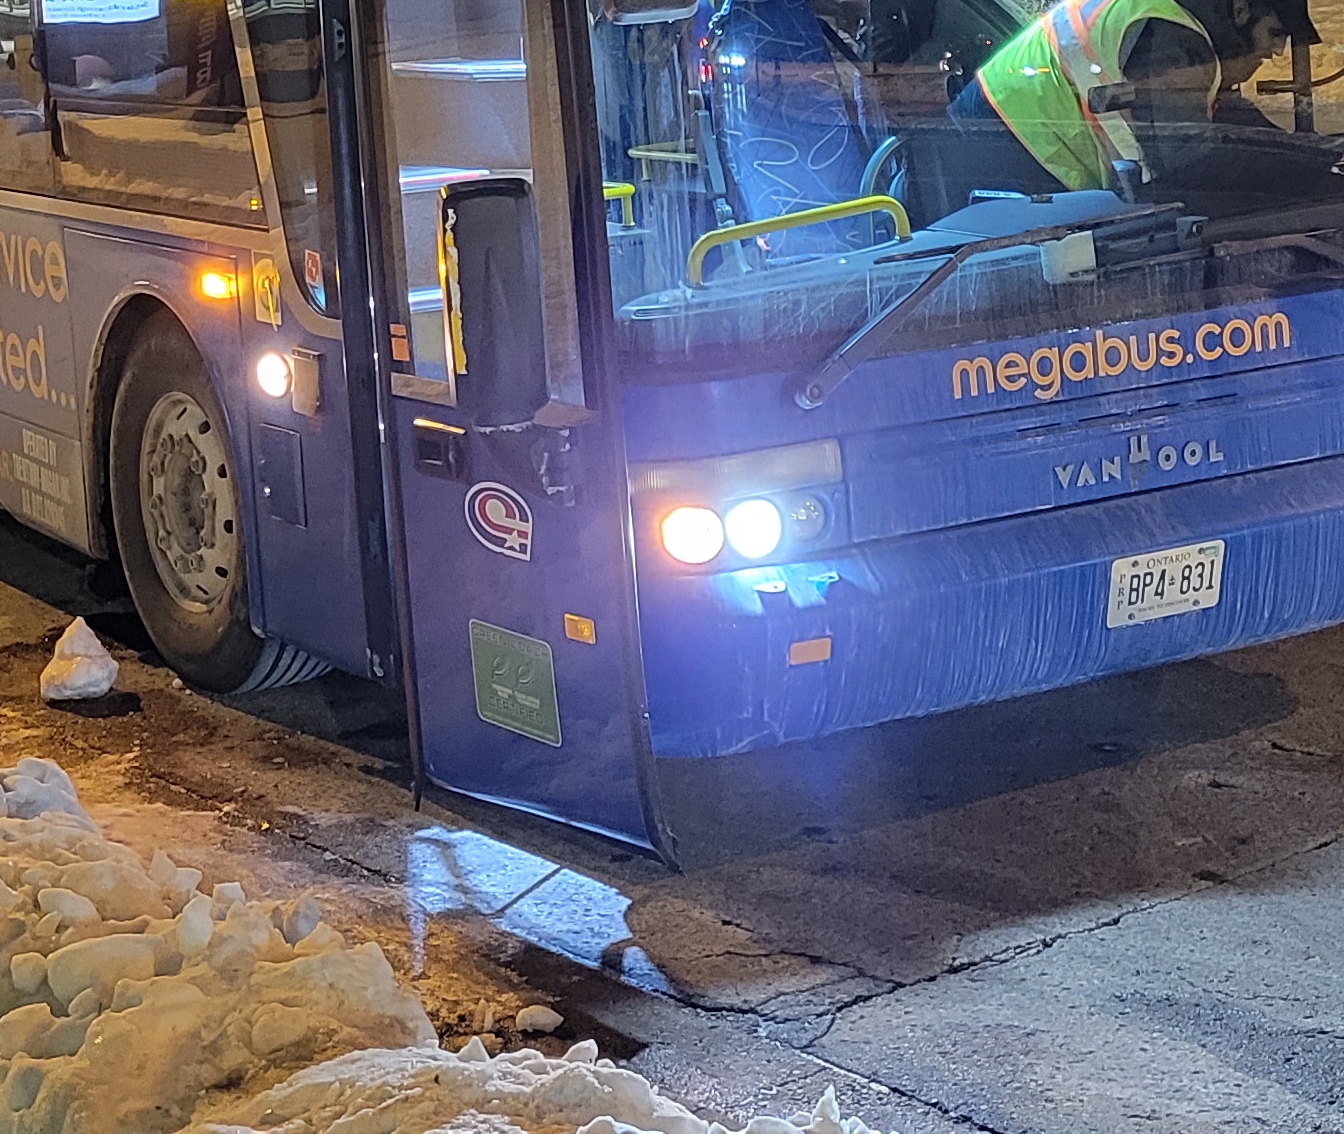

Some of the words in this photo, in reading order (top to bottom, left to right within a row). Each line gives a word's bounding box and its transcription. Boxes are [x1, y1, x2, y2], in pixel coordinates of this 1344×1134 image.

[952, 312, 1291, 400] megabus.com
[1128, 568, 1167, 606] BP4
[1179, 559, 1215, 595] 831
[1146, 551, 1191, 569] ONTARIO
